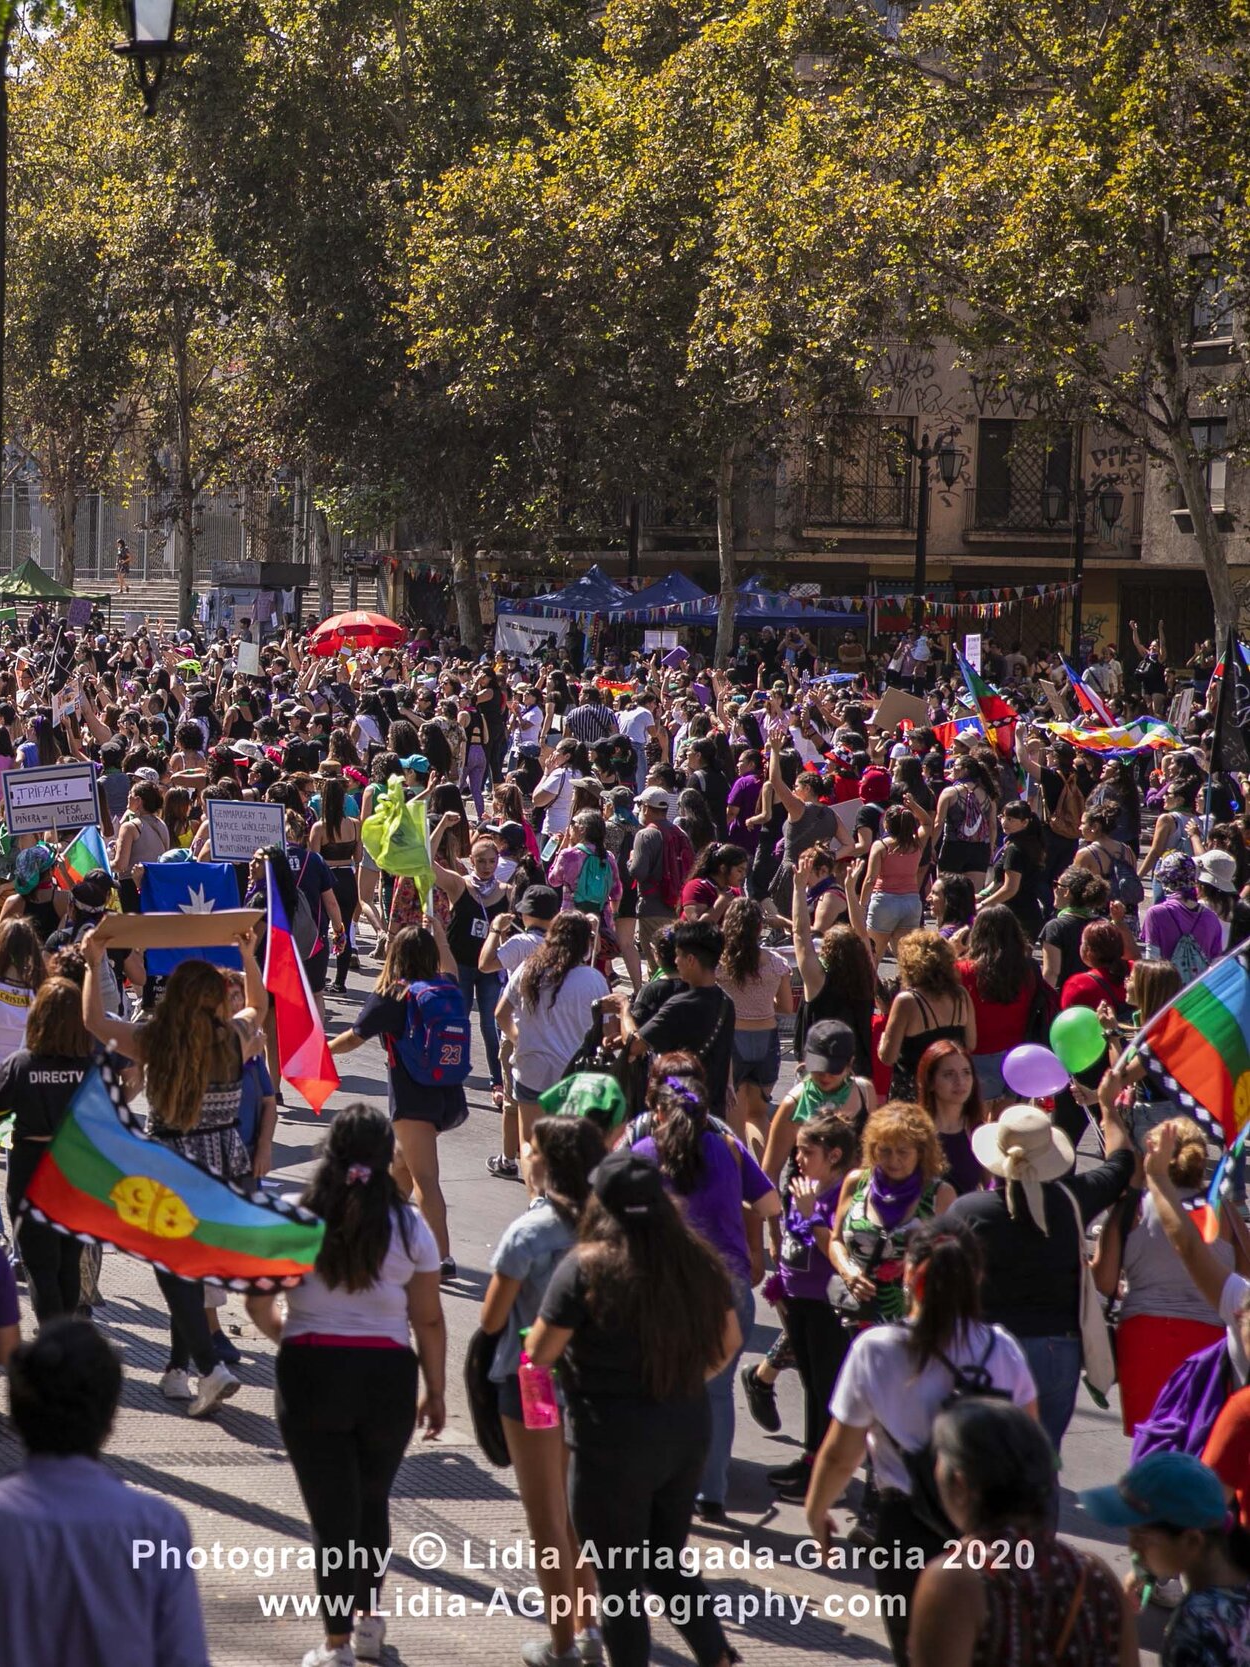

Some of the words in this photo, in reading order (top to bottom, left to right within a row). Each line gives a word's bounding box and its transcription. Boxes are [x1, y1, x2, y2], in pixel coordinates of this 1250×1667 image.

[57, 804, 83, 815] WESA
[15, 813, 41, 824] PIÑERA
[439, 1043, 462, 1066] 23
[29, 1070, 85, 1084] DIRECTV
